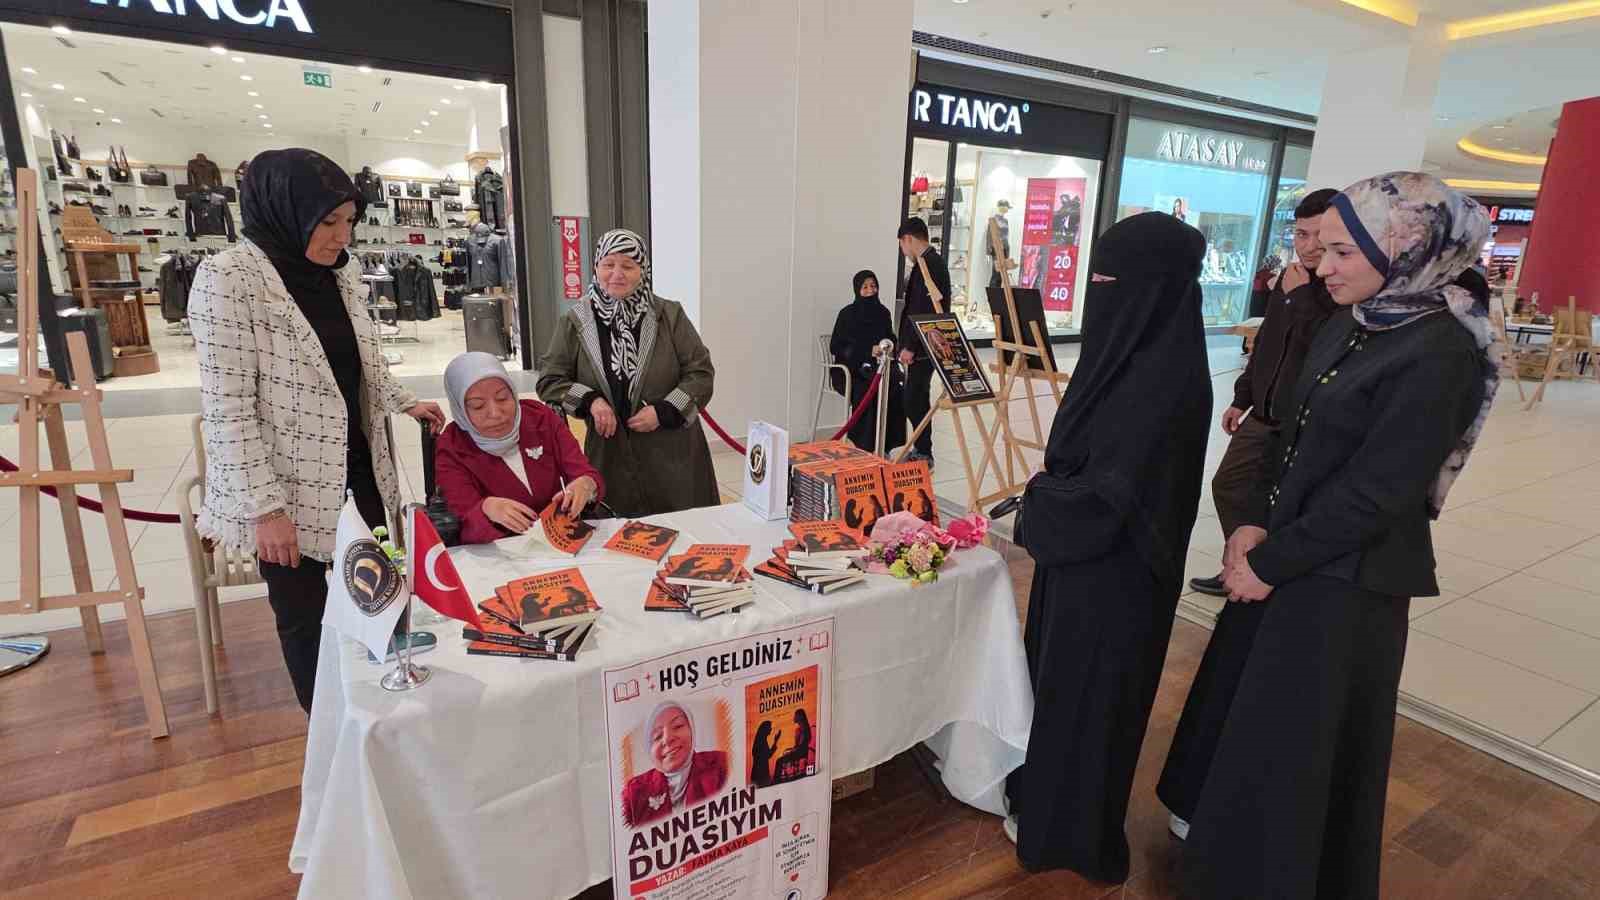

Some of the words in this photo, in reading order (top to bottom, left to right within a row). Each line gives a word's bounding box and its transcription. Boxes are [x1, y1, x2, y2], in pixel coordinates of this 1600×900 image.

[937, 93, 1023, 135] TANCA
[1157, 130, 1243, 169] ATASAY
[1053, 255, 1071, 269] 20
[1050, 287, 1069, 301] 40
[659, 660, 699, 691] HOŞ
[706, 638, 792, 676] GELDİNİZ
[759, 677, 805, 700] ANNEMİN
[759, 691, 805, 714] DUASIYIM
[628, 786, 756, 856] ANNEMİN
[628, 798, 782, 882] DUASIYIM
